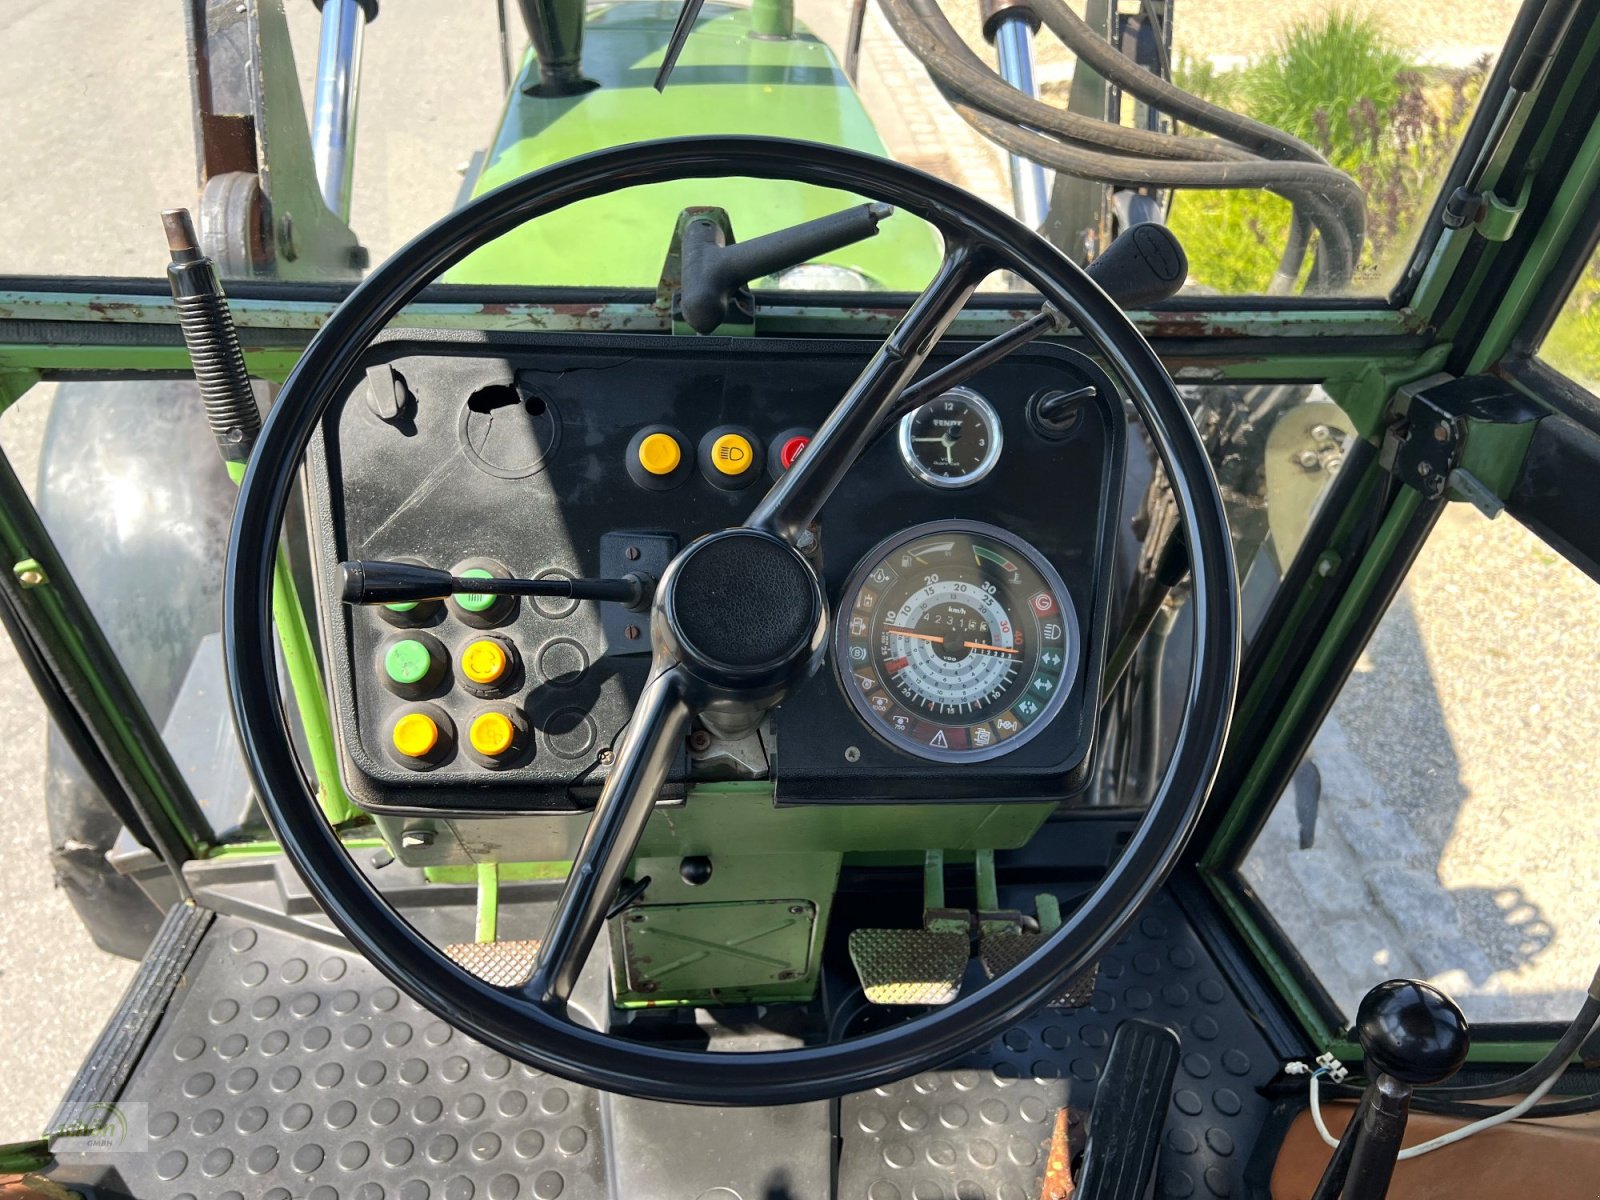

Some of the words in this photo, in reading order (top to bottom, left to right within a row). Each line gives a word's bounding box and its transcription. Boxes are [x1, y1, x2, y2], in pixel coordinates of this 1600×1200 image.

[885, 610, 896, 624] 10
[924, 574, 939, 585] 20
[982, 581, 996, 594] 30
[901, 606, 912, 616] 10
[924, 586, 934, 596] 15
[954, 584, 967, 592] 20
[982, 595, 994, 606] 25
[1000, 620, 1010, 633] 30
[948, 606, 966, 615] km/h
[900, 688, 911, 698] 20
[992, 691, 1000, 700] 10
